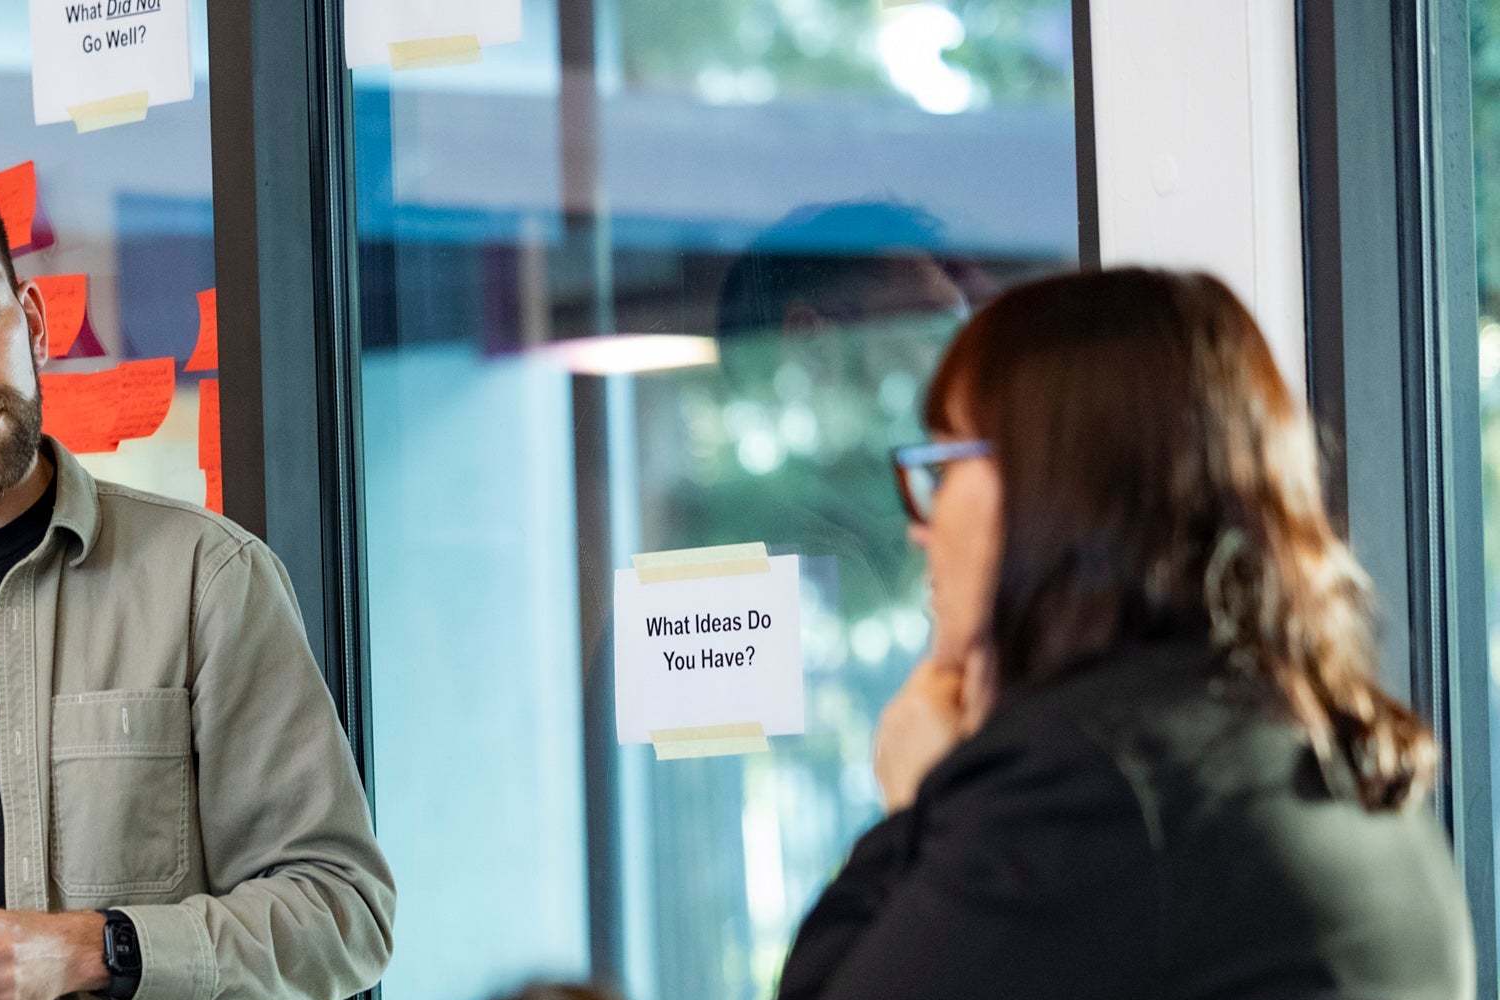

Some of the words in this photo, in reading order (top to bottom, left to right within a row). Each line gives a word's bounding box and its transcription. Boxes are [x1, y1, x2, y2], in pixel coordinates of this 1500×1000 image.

[65, 4, 102, 24] What
[106, 0, 132, 17] Did
[82, 35, 102, 53] Go
[106, 25, 147, 48] Well?
[646, 614, 690, 637] What
[695, 612, 742, 634] Ideas
[748, 609, 772, 630] Do
[663, 650, 695, 671] You
[701, 645, 756, 669] Have?
